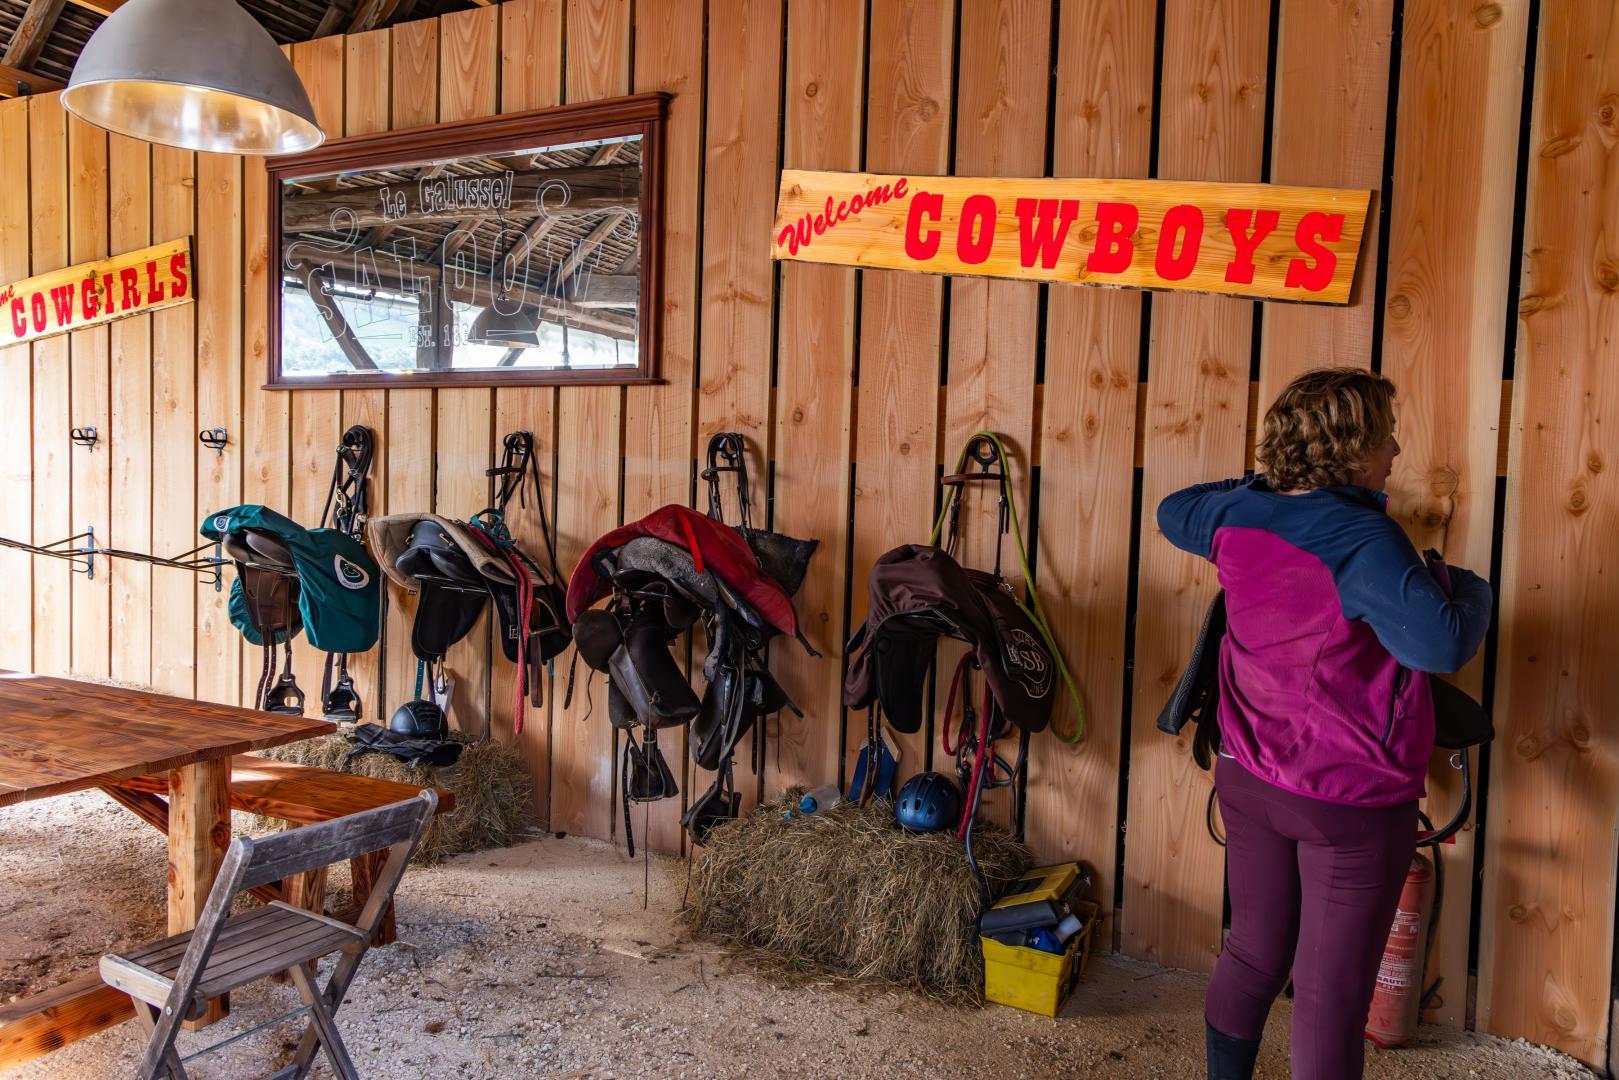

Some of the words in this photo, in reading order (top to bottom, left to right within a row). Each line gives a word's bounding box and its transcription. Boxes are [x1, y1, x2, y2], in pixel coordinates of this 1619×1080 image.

[379, 185, 407, 223] Le
[419, 170, 514, 214] Galussel
[777, 177, 909, 257] Welcome
[904, 191, 1346, 293] COWBOYS
[10, 252, 189, 338] COWGIRLS
[305, 228, 603, 344] SALOON
